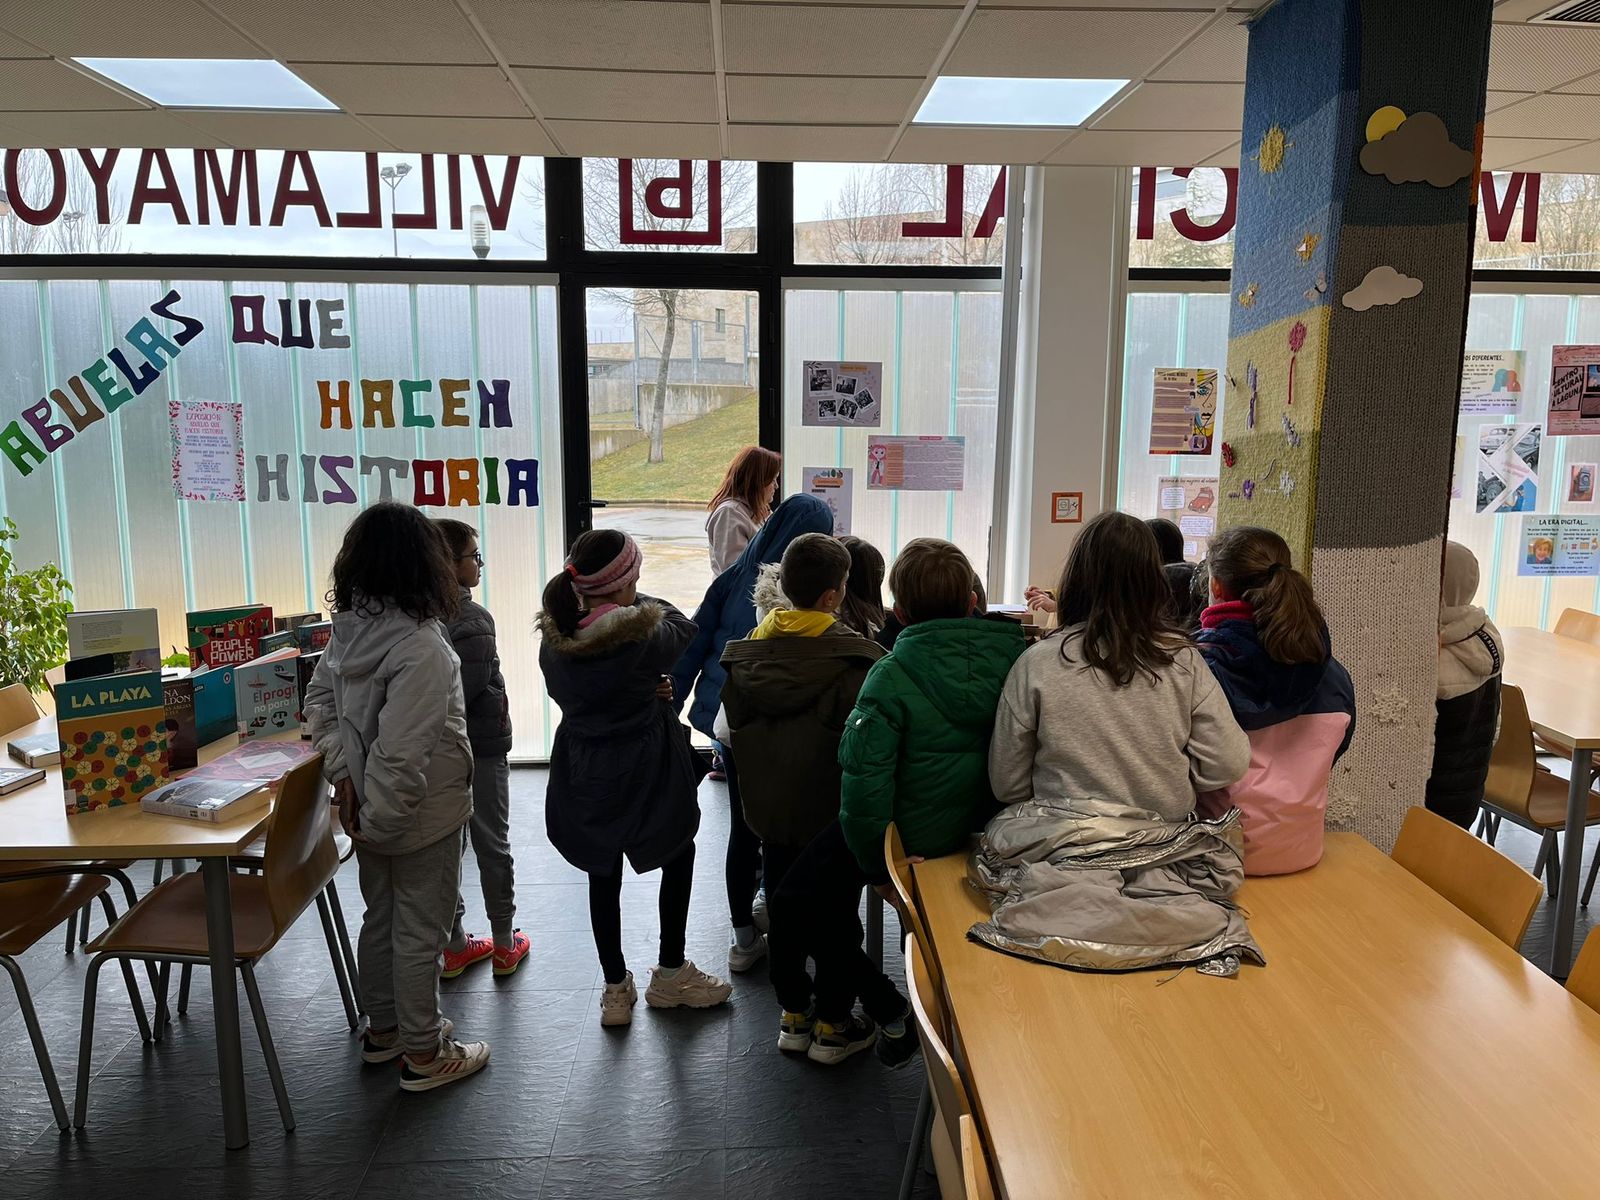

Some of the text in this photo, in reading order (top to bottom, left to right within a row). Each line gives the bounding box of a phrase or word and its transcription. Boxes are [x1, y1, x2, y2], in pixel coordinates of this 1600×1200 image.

[0, 290, 351, 476] ABUELAS QUE
[317, 379, 513, 429] HACEN
[255, 454, 540, 507] HISTORIA
[210, 638, 252, 652] PEOPLE
[210, 648, 255, 664] POWER
[71, 686, 152, 708] LA PLAYA
